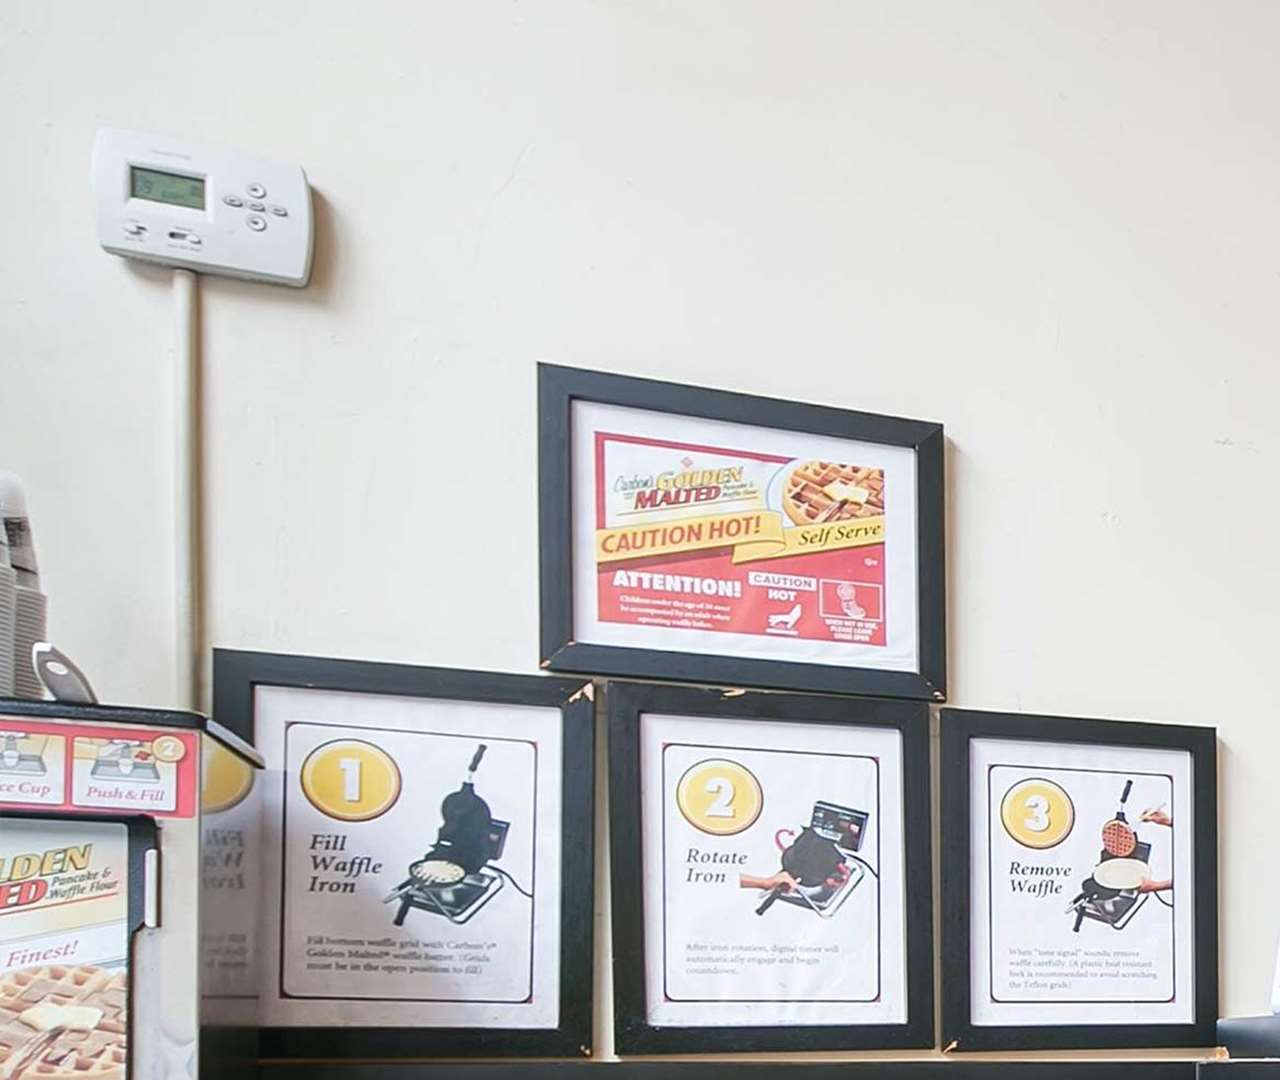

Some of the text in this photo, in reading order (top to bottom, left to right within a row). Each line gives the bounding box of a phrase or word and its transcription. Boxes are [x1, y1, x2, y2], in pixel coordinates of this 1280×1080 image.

[656, 466, 744, 491] GOLDEN
[634, 485, 722, 510] MALTED
[601, 516, 761, 554] CAUTION HOT!
[800, 524, 881, 546] Self Serve
[613, 570, 742, 598] ATTENTION!
[753, 573, 813, 589] CAUTION
[768, 590, 797, 602] HOT
[338, 757, 361, 801] 1
[18, 782, 51, 798] Cup
[87, 786, 166, 802] Push & Fill
[705, 776, 736, 818] 2
[1023, 795, 1051, 832] 3
[310, 833, 347, 852] Fill
[309, 854, 382, 878] Waffle
[685, 848, 748, 866] Rotate
[52, 870, 99, 886] Pancake
[685, 867, 727, 884] Iron
[1009, 861, 1072, 877] Remove
[49, 884, 87, 900] Waffle
[91, 880, 119, 893] Flour
[308, 877, 356, 894] Iron
[1010, 879, 1063, 898] Waffle
[6, 940, 79, 967] Finest!
